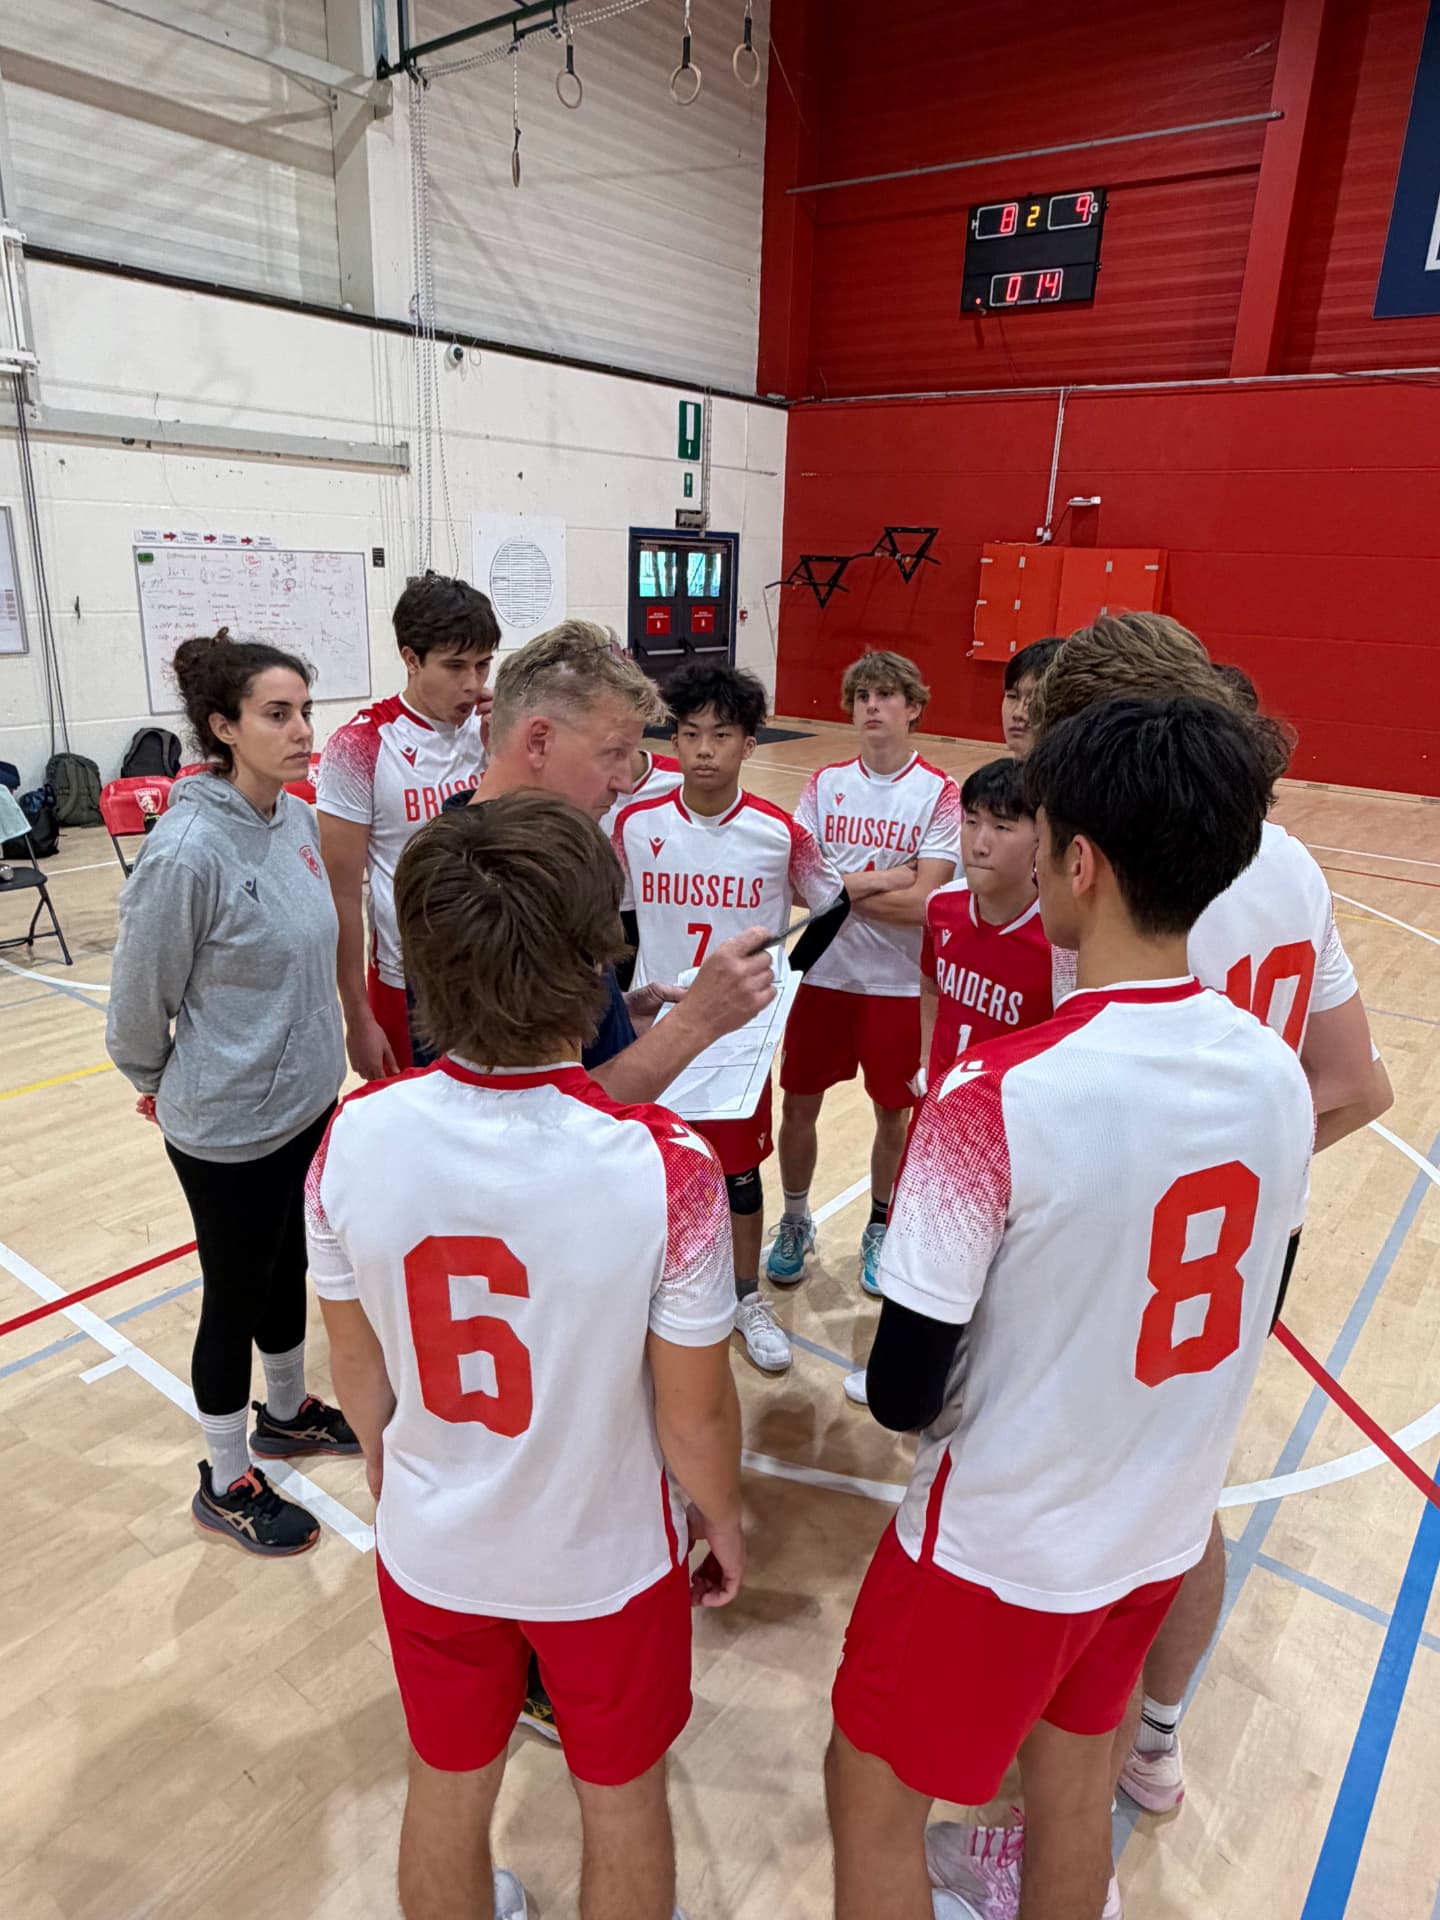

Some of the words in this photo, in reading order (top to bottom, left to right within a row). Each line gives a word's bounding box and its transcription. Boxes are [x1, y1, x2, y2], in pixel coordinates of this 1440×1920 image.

[1027, 206, 1040, 227] 2
[1076, 195, 1090, 221] 9
[1091, 203, 1099, 213] G
[404, 771, 486, 822] BRU
[824, 815, 921, 854] BRUSSELS
[642, 871, 763, 909] BRUSSELS
[687, 922, 713, 967] 7
[936, 956, 1023, 1025] RAIDERS
[1226, 939, 1316, 1053] 10
[1135, 1160, 1260, 1388] 8
[403, 1235, 533, 1438] 6
